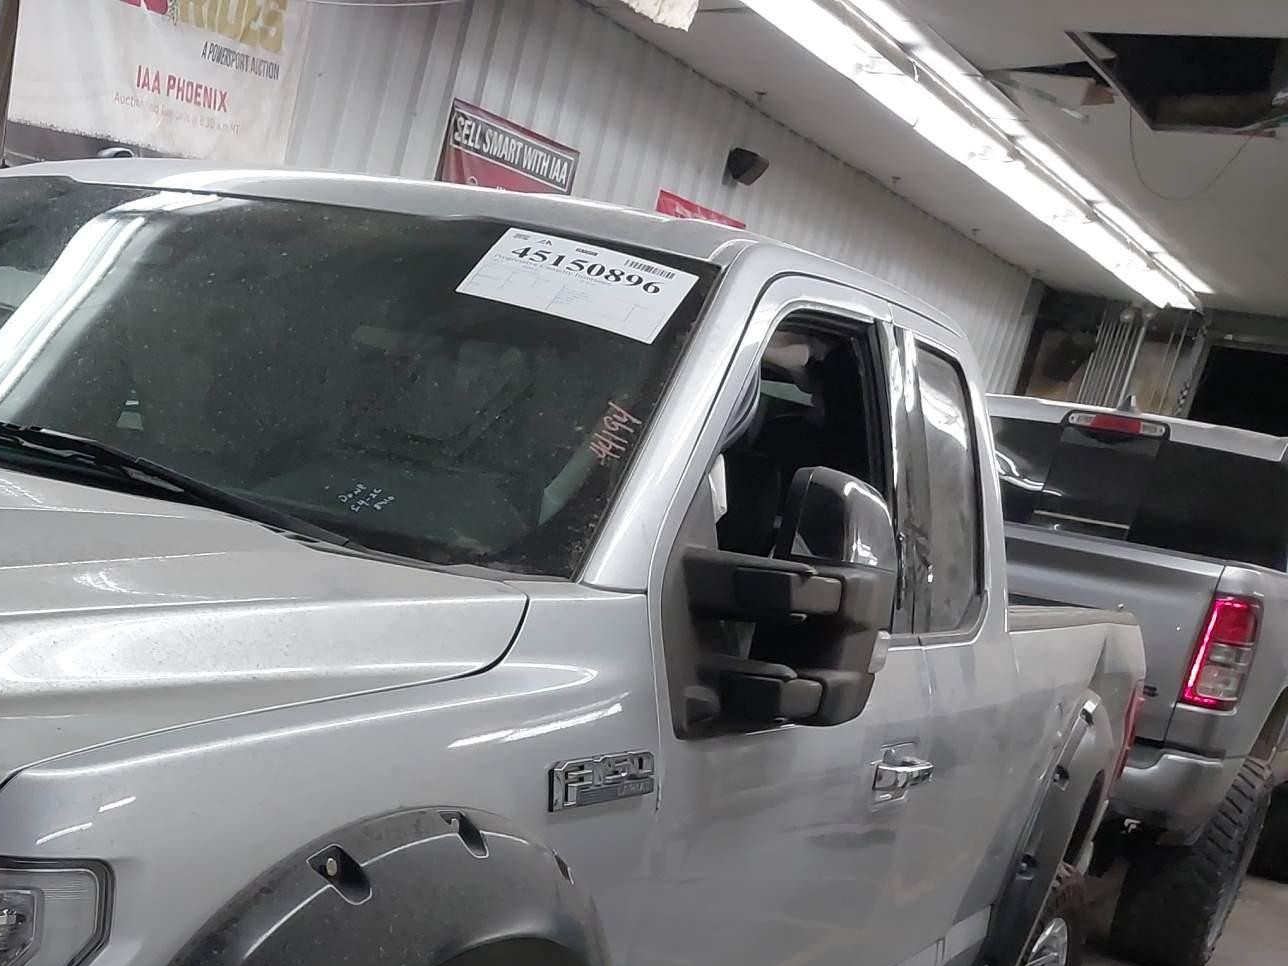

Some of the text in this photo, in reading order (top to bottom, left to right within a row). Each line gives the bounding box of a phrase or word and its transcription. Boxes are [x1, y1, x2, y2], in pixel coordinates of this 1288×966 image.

[201, 41, 280, 80] A POWERSPORT AUCTION
[136, 64, 228, 112] IAA PHOENIX
[454, 116, 568, 185] SELL SMART WITH IAA
[512, 246, 661, 294] 45150896
